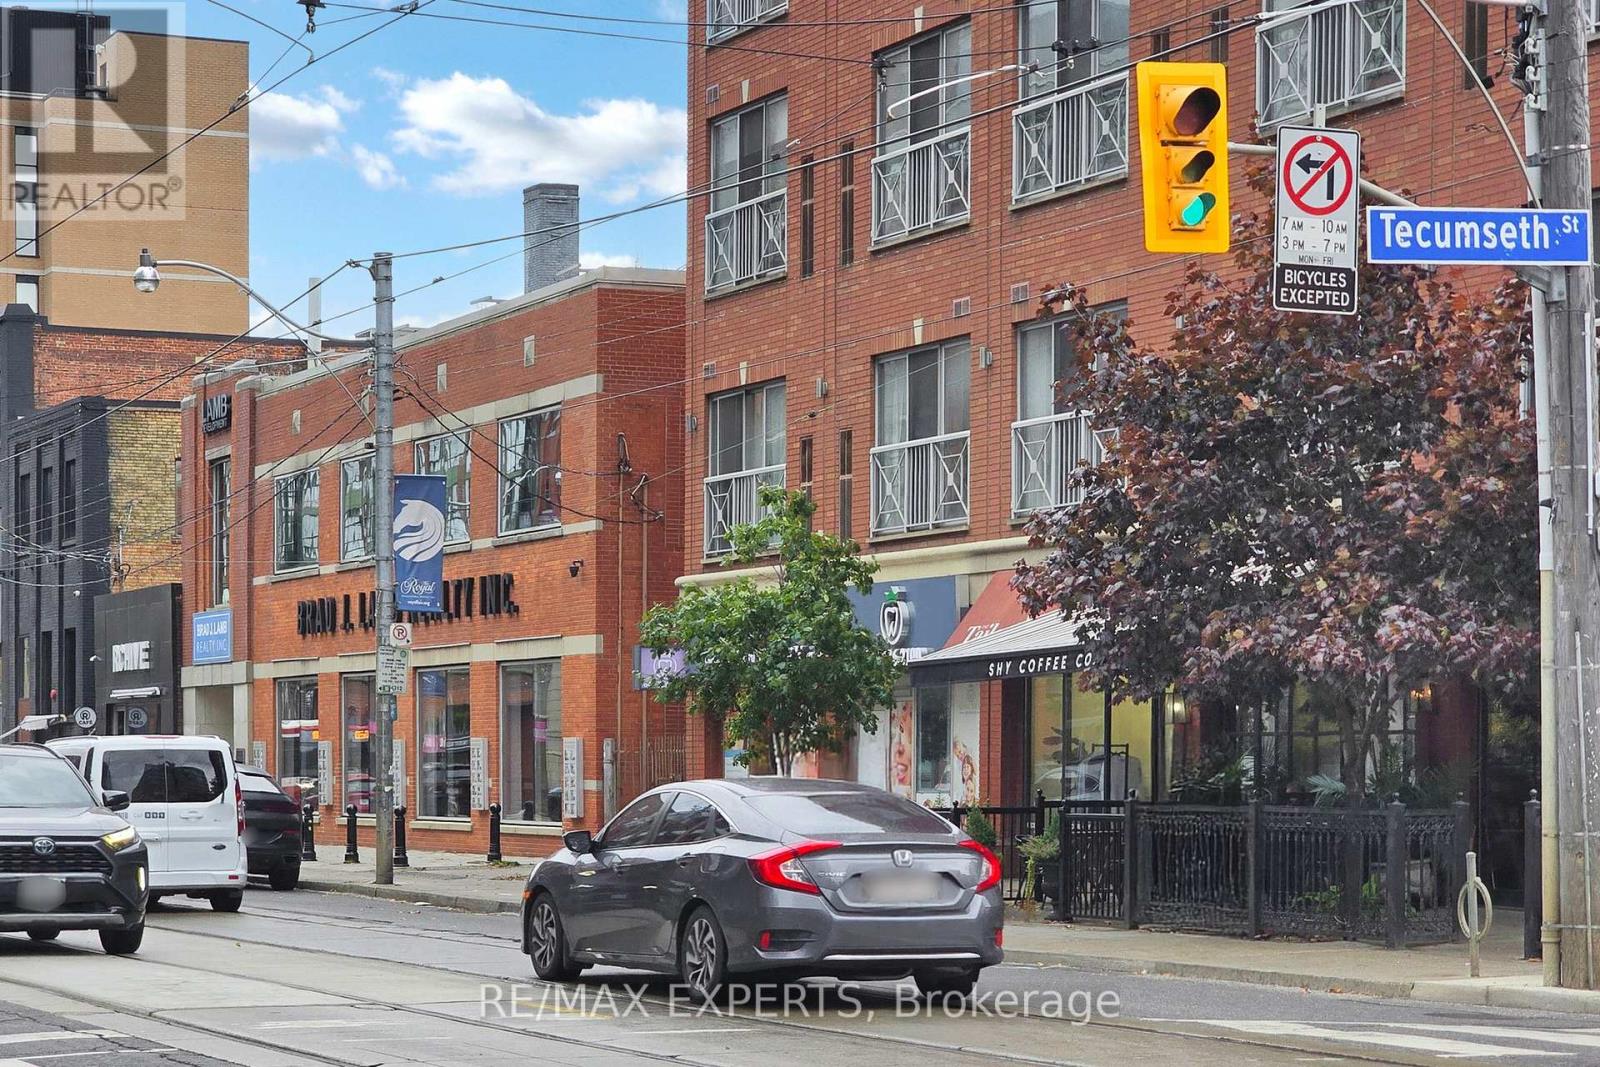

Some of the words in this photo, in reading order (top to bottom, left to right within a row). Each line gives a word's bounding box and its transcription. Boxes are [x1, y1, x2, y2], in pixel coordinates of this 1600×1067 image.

[1281, 216, 1289, 230] 7
[1291, 221, 1304, 231] AM
[1322, 219, 1334, 234] 10
[1336, 223, 1348, 234] AM
[1380, 212, 1549, 250] Tecumseth
[1562, 215, 1579, 234] St
[1282, 235, 1290, 250] 3
[1292, 239, 1305, 250] PM
[1323, 238, 1331, 252] 7
[1334, 242, 1346, 253] PM
[1322, 256, 1334, 265] FRI
[1284, 269, 1347, 288] BICYCLES
[1280, 287, 1350, 307] EXCEPTED
[400, 576, 436, 596] Royal
[297, 597, 337, 636] BRAD
[480, 572, 519, 618] INC.
[196, 622, 209, 637] BRAD
[213, 620, 228, 635] LAMB
[196, 640, 216, 656] REALTY
[988, 660, 1012, 677] SHY
[1018, 655, 1068, 674] COFFEE
[1075, 652, 1096, 668] CO.
